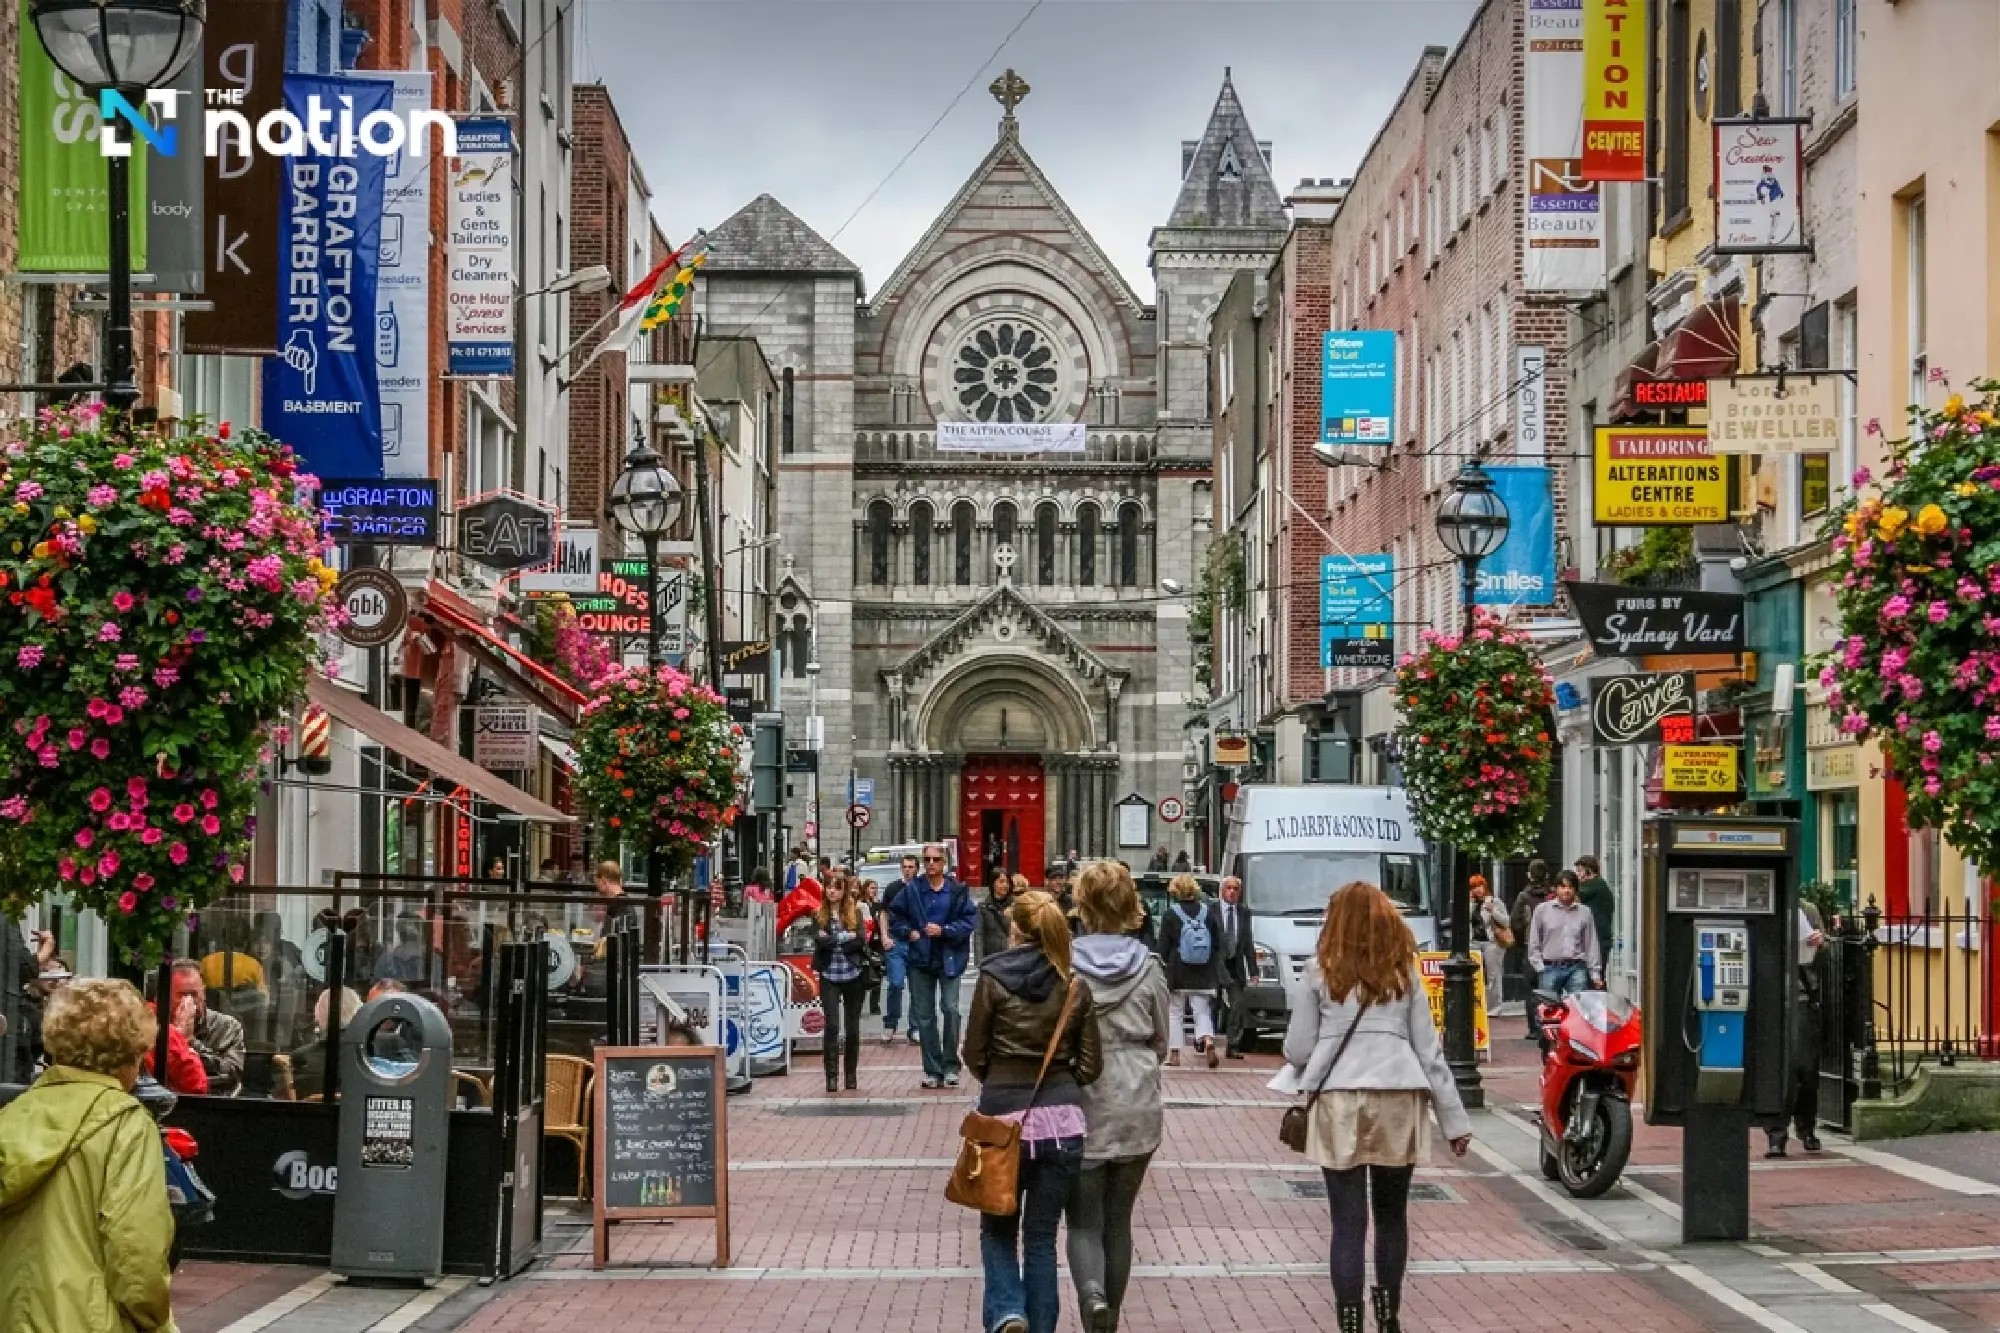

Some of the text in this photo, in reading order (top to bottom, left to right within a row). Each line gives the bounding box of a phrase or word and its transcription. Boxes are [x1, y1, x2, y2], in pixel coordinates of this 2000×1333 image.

[1530, 14, 1583, 29] Beau
[1587, 130, 1641, 151] CENTRE
[385, 187, 424, 199] enders
[459, 190, 501, 203] Ladies
[152, 200, 193, 218] body
[1530, 196, 1598, 210] Essence
[461, 217, 501, 231] Gents
[1527, 217, 1597, 233] Beauty
[288, 164, 320, 322] BARBER
[452, 232, 509, 247] Tailoring
[325, 165, 360, 352] GRAFTON
[468, 255, 494, 269] Dry
[451, 268, 508, 281] Cleaners
[450, 292, 510, 305] One Hour
[455, 322, 507, 334] Services
[1636, 382, 1707, 403] RESTAUR
[1737, 384, 1810, 399] Loran
[283, 400, 363, 414] BASEMENT
[943, 425, 966, 436] THE
[1710, 418, 1837, 440] JEWELLER
[1617, 438, 1708, 455] TAILORING
[1608, 466, 1720, 482] ALTERATIONS
[343, 487, 432, 507] GRAFTON
[1631, 485, 1695, 502] CENTRE
[1607, 506, 1719, 518] LADIES & GENTS
[463, 511, 545, 557] EAT
[613, 562, 649, 577] WINE
[1475, 569, 1544, 590] Smiles
[599, 572, 649, 611] HOES
[349, 594, 384, 618] gbk
[1616, 597, 1683, 611] FURS BY
[580, 614, 650, 633] OUNGE
[1596, 612, 1740, 653] Sydney Vard
[1664, 728, 1694, 742] BAR
[1376, 817, 1402, 842] LTD
